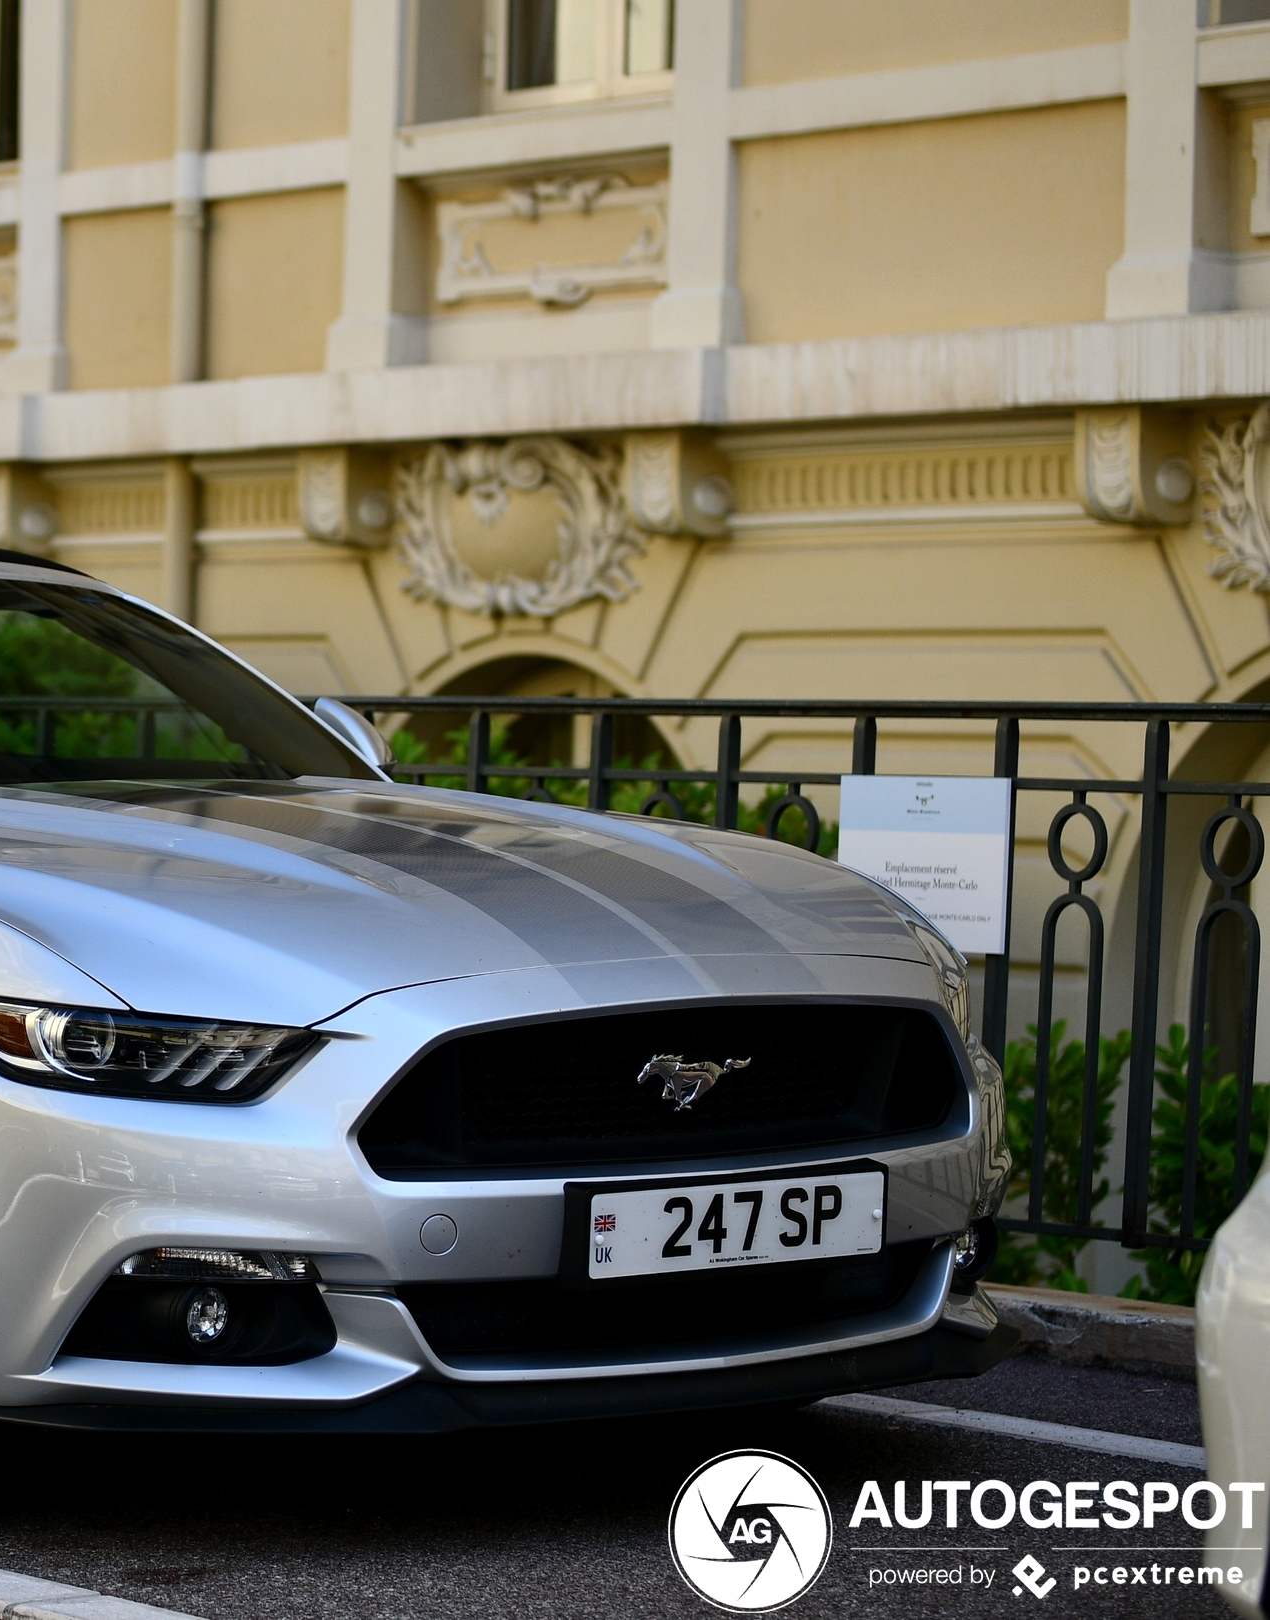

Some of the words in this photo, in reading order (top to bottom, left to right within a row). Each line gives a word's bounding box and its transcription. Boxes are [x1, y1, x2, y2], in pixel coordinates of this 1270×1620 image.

[885, 861, 932, 875] Emplacement
[933, 864, 957, 875] réservé
[894, 877, 931, 892] Hermitage
[932, 878, 978, 891] Monte-Carlo
[662, 1190, 764, 1259] 247
[779, 1184, 842, 1248] SP
[595, 1246, 613, 1264] UK
